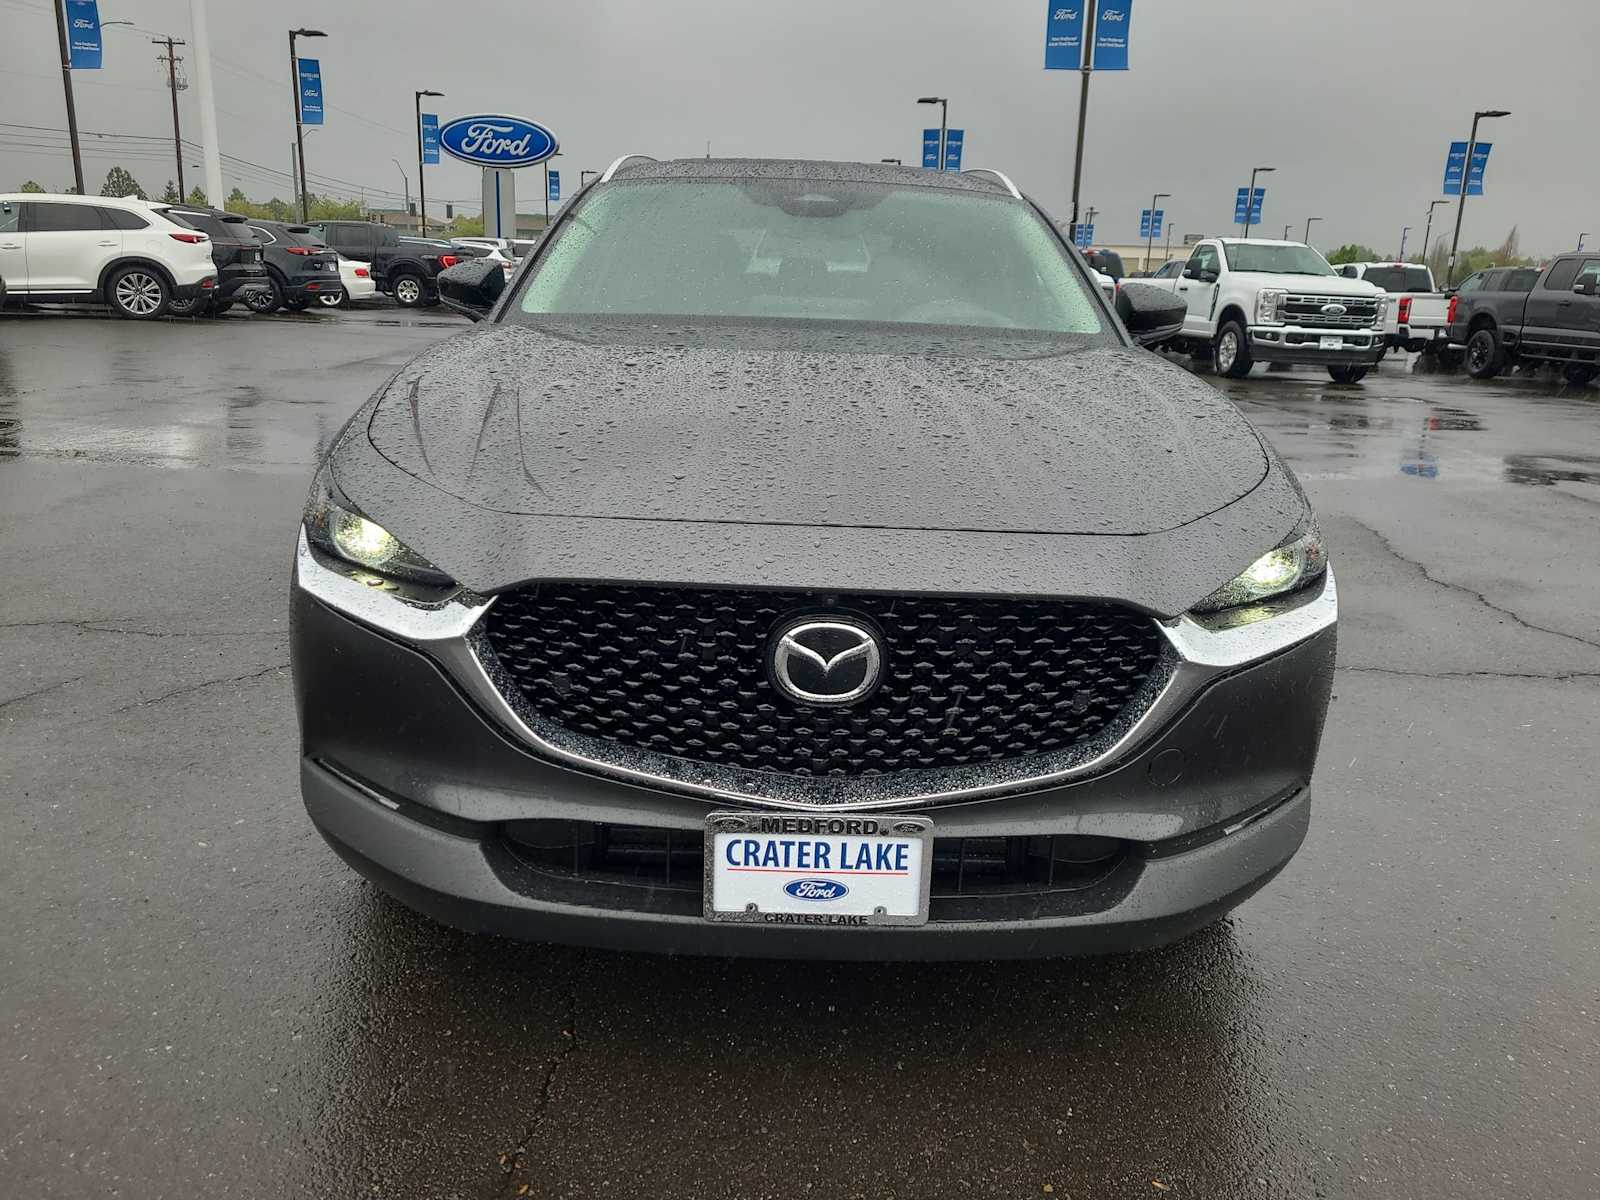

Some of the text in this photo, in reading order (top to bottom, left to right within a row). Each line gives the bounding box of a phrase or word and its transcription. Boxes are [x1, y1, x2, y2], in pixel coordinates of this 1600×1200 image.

[1054, 8, 1079, 20] Ford
[1102, 9, 1125, 21] Ford
[461, 123, 532, 155] Ford
[761, 816, 879, 835] MEDFORD
[725, 838, 909, 871] CRATER LAKE
[796, 881, 836, 899] Ford
[764, 912, 869, 926] CRATER LAKE
